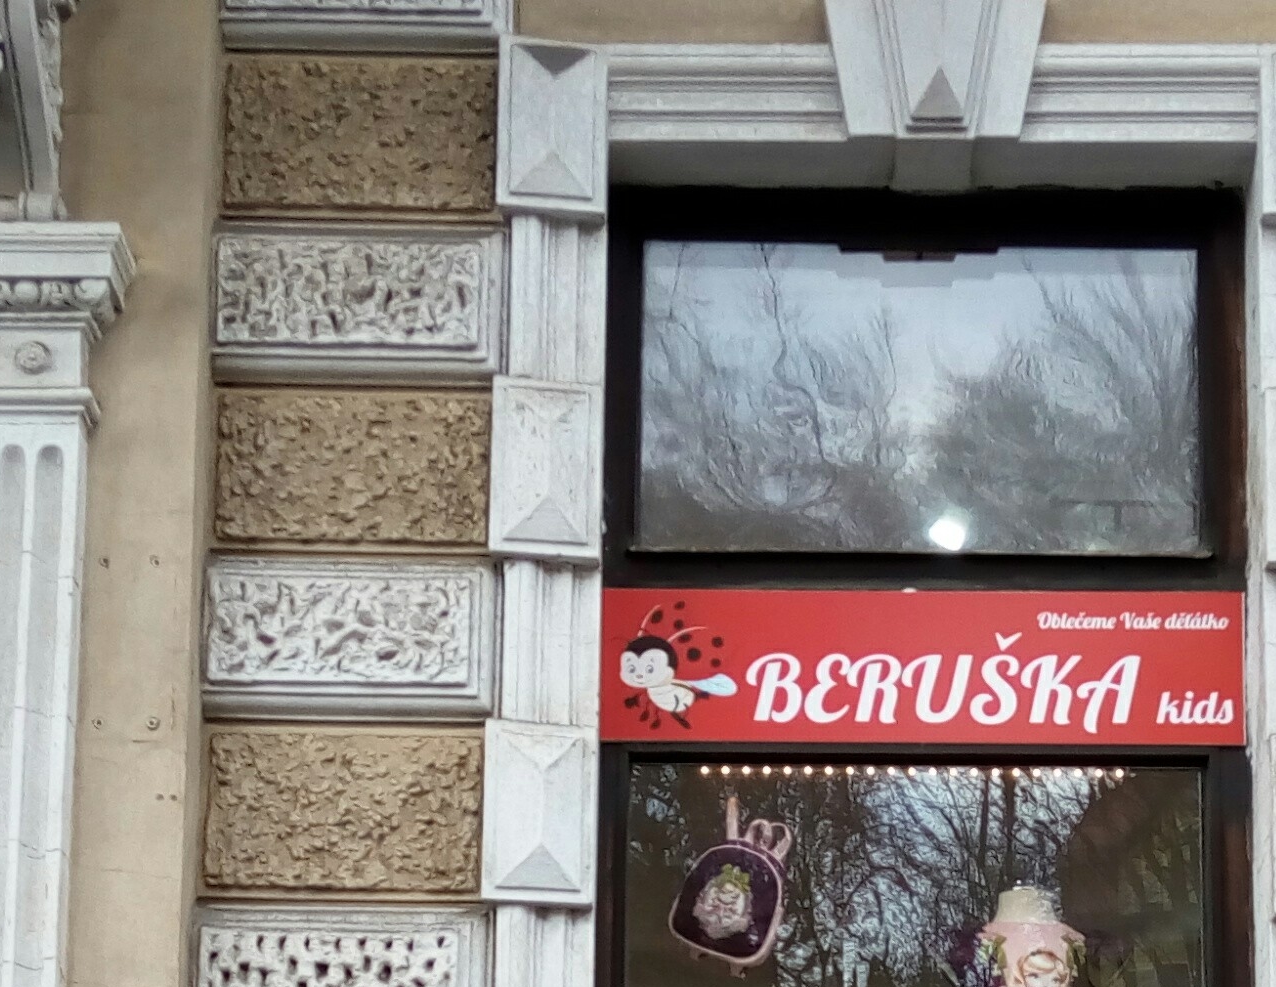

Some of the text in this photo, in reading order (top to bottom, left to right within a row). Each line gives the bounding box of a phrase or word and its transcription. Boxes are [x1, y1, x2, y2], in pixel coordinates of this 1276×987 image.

[1036, 611, 1117, 630] Oblečeme
[1119, 611, 1160, 630] Vaše
[745, 631, 1234, 734] BERUŠKA kids
